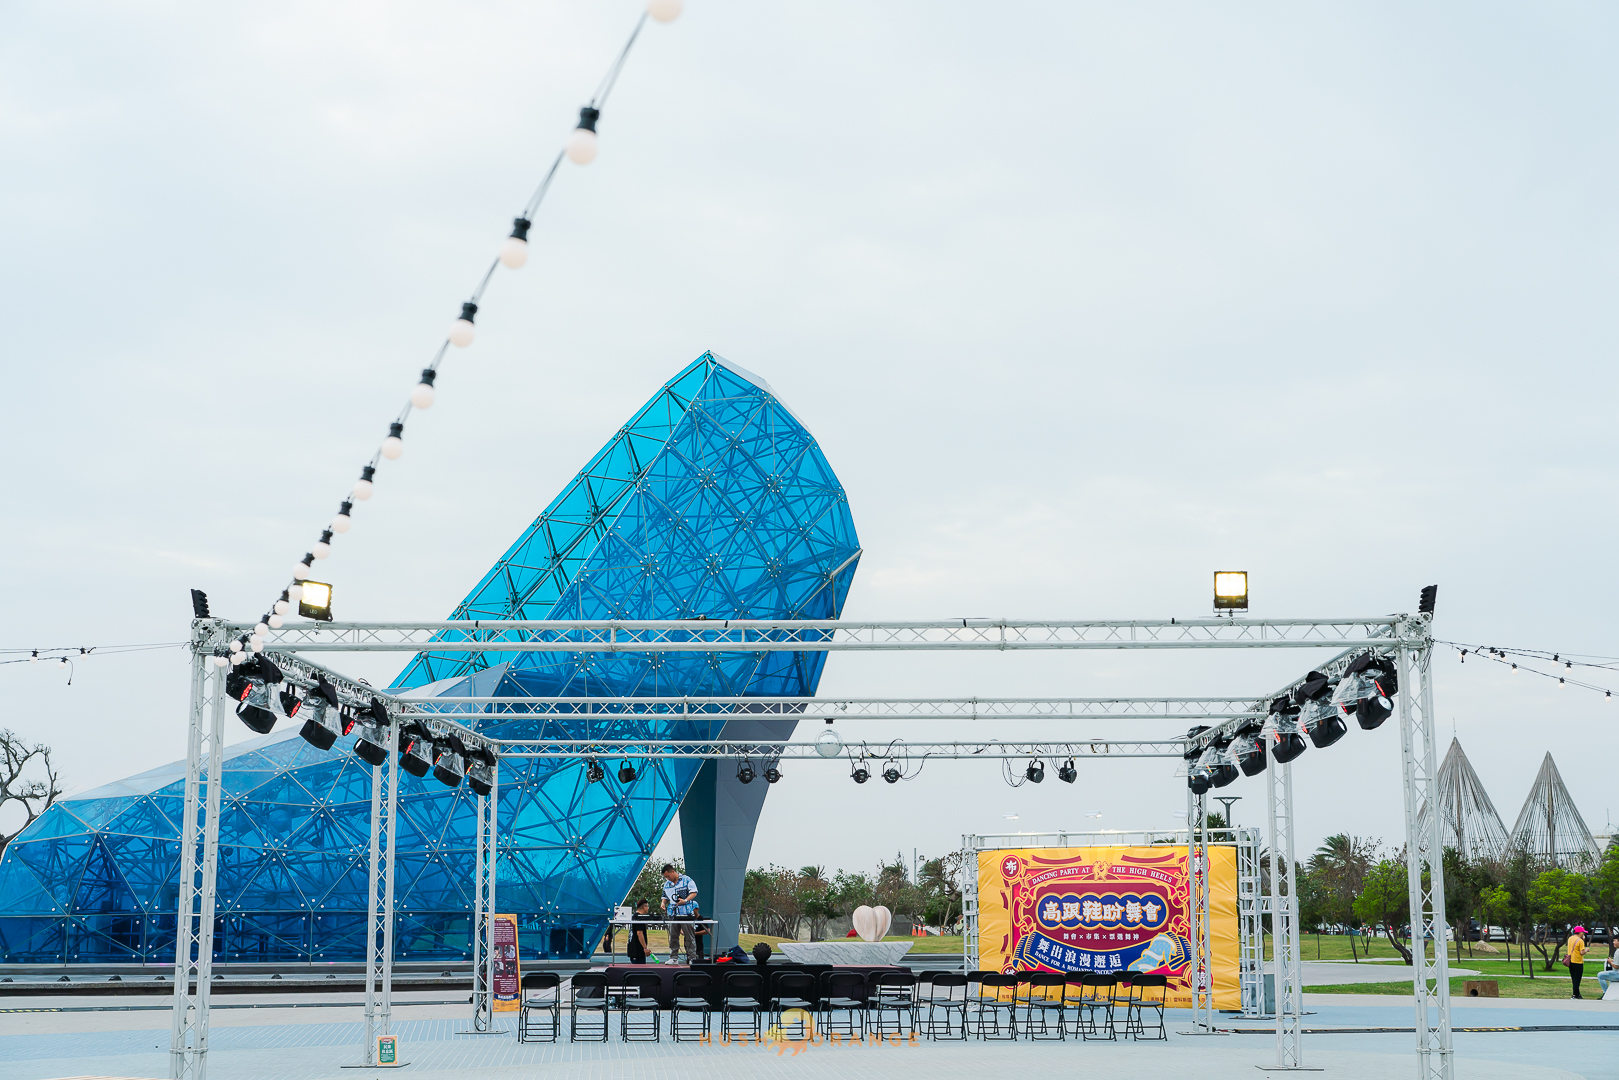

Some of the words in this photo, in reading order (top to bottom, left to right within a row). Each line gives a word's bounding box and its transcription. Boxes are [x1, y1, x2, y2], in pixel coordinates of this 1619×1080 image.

[1005, 860, 1018, 875] 布
[1032, 870, 1058, 885] DANCING
[1060, 867, 1080, 876] PARTY
[1081, 866, 1091, 874] AT
[1129, 867, 1148, 875] HIGH
[1150, 870, 1173, 883] HEELS
[1043, 900, 1162, 924] 高跟鞋盼舞會
[1034, 950, 1050, 963] DANCE
[1050, 959, 1061, 968] FOR
[1036, 937, 1122, 969] 舞出浪漫邂逅
